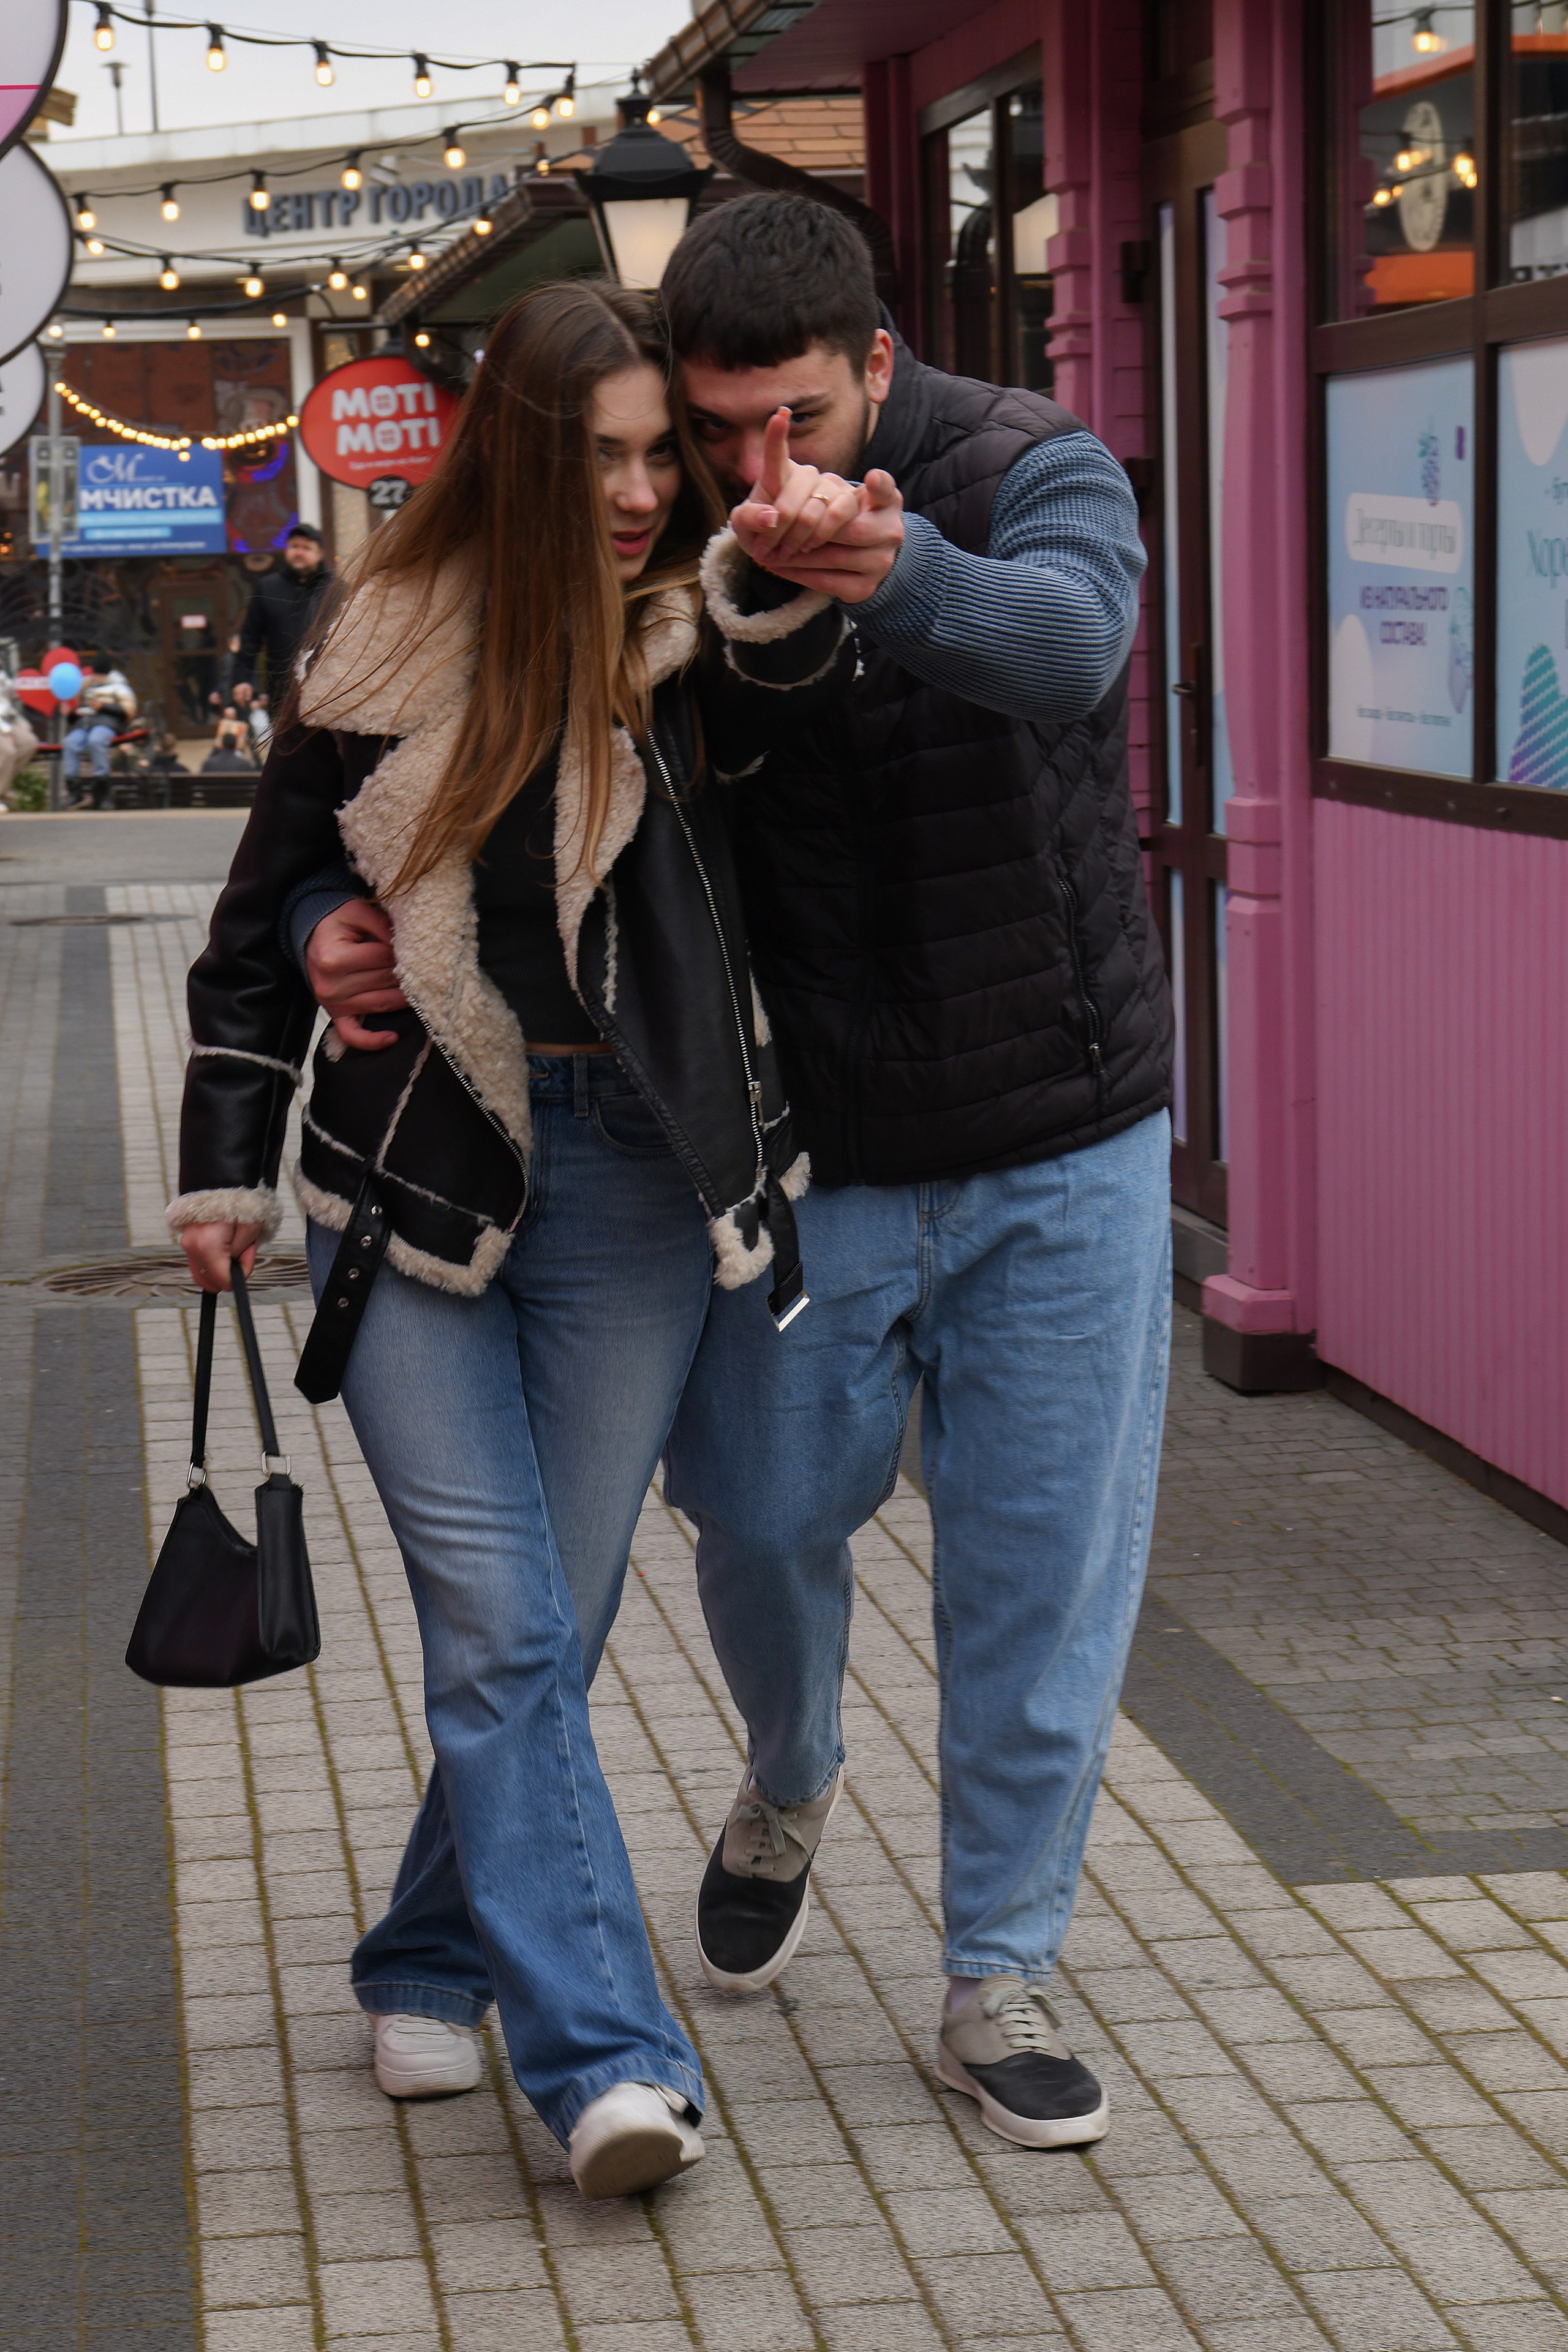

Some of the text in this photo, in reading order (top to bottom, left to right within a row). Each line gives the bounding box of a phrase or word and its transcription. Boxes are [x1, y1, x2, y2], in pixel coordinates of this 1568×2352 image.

[244, 189, 360, 237] ЦЕНТР
[79, 486, 218, 510] МЧИСТКА
[370, 480, 409, 505] 27
